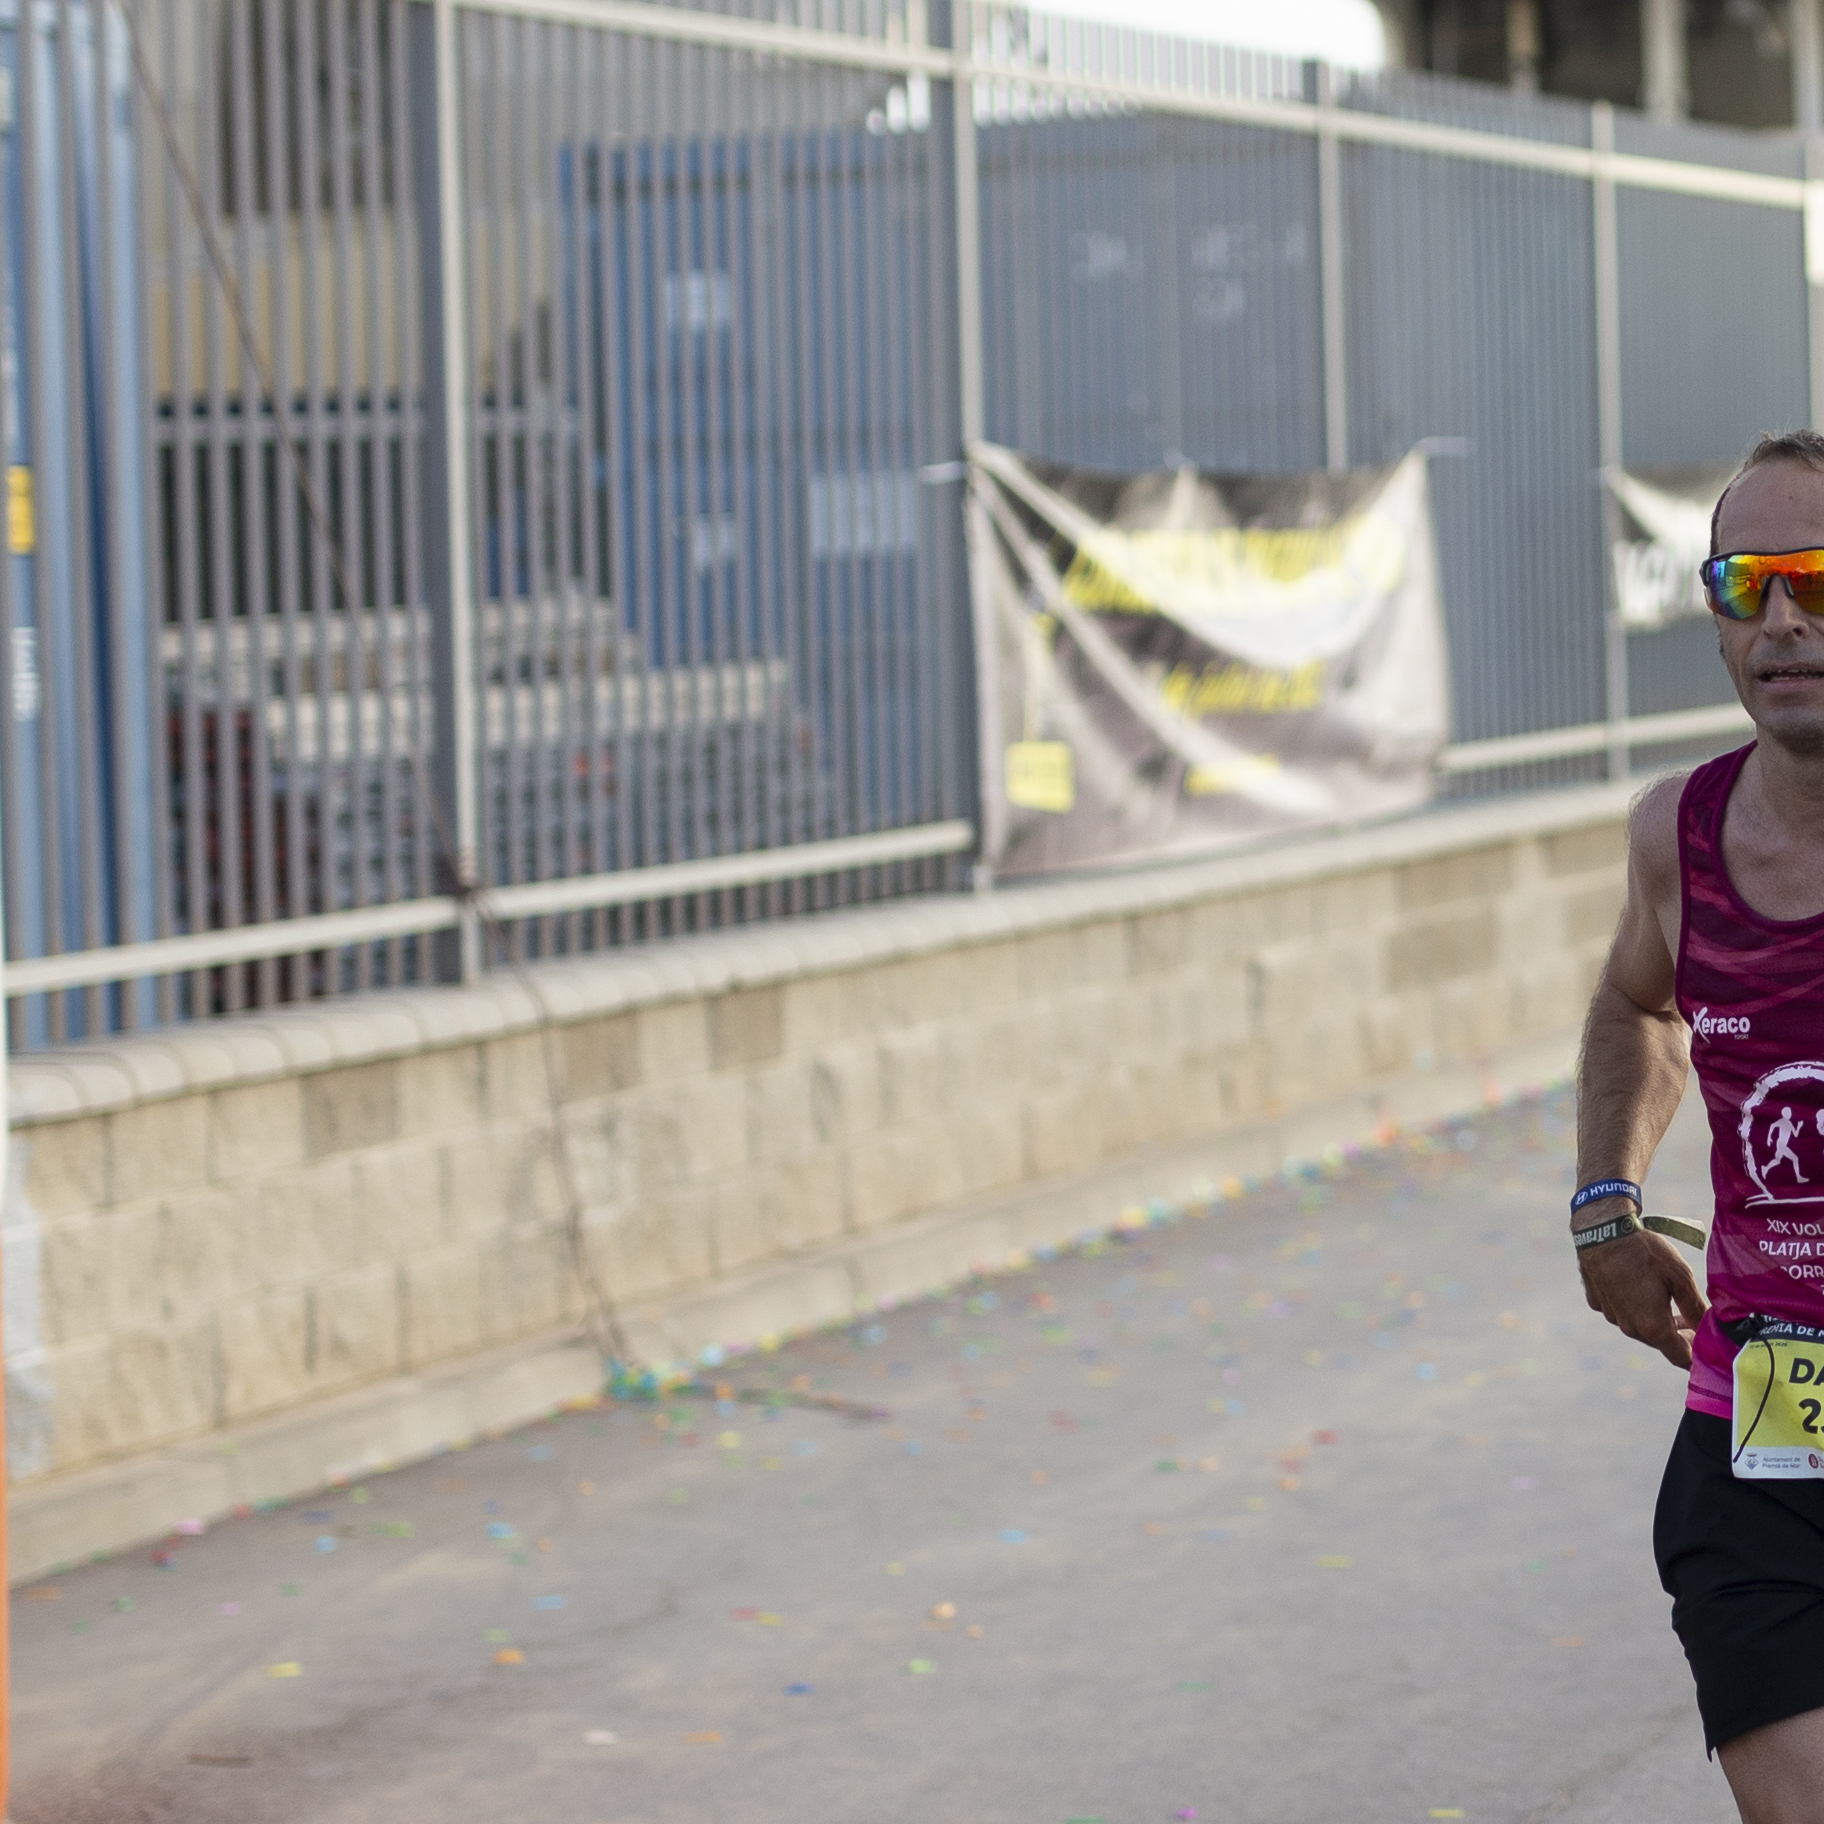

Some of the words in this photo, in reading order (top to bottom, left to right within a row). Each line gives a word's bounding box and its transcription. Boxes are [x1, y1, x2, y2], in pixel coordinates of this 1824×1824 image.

[1692, 1006, 1751, 1044] Xeraco
[1589, 1182, 1637, 1196] HYUNDAI
[1766, 1218, 1791, 1235] XIX
[1759, 1240, 1812, 1260] PLATJA
[1796, 1325, 1815, 1336] DE
